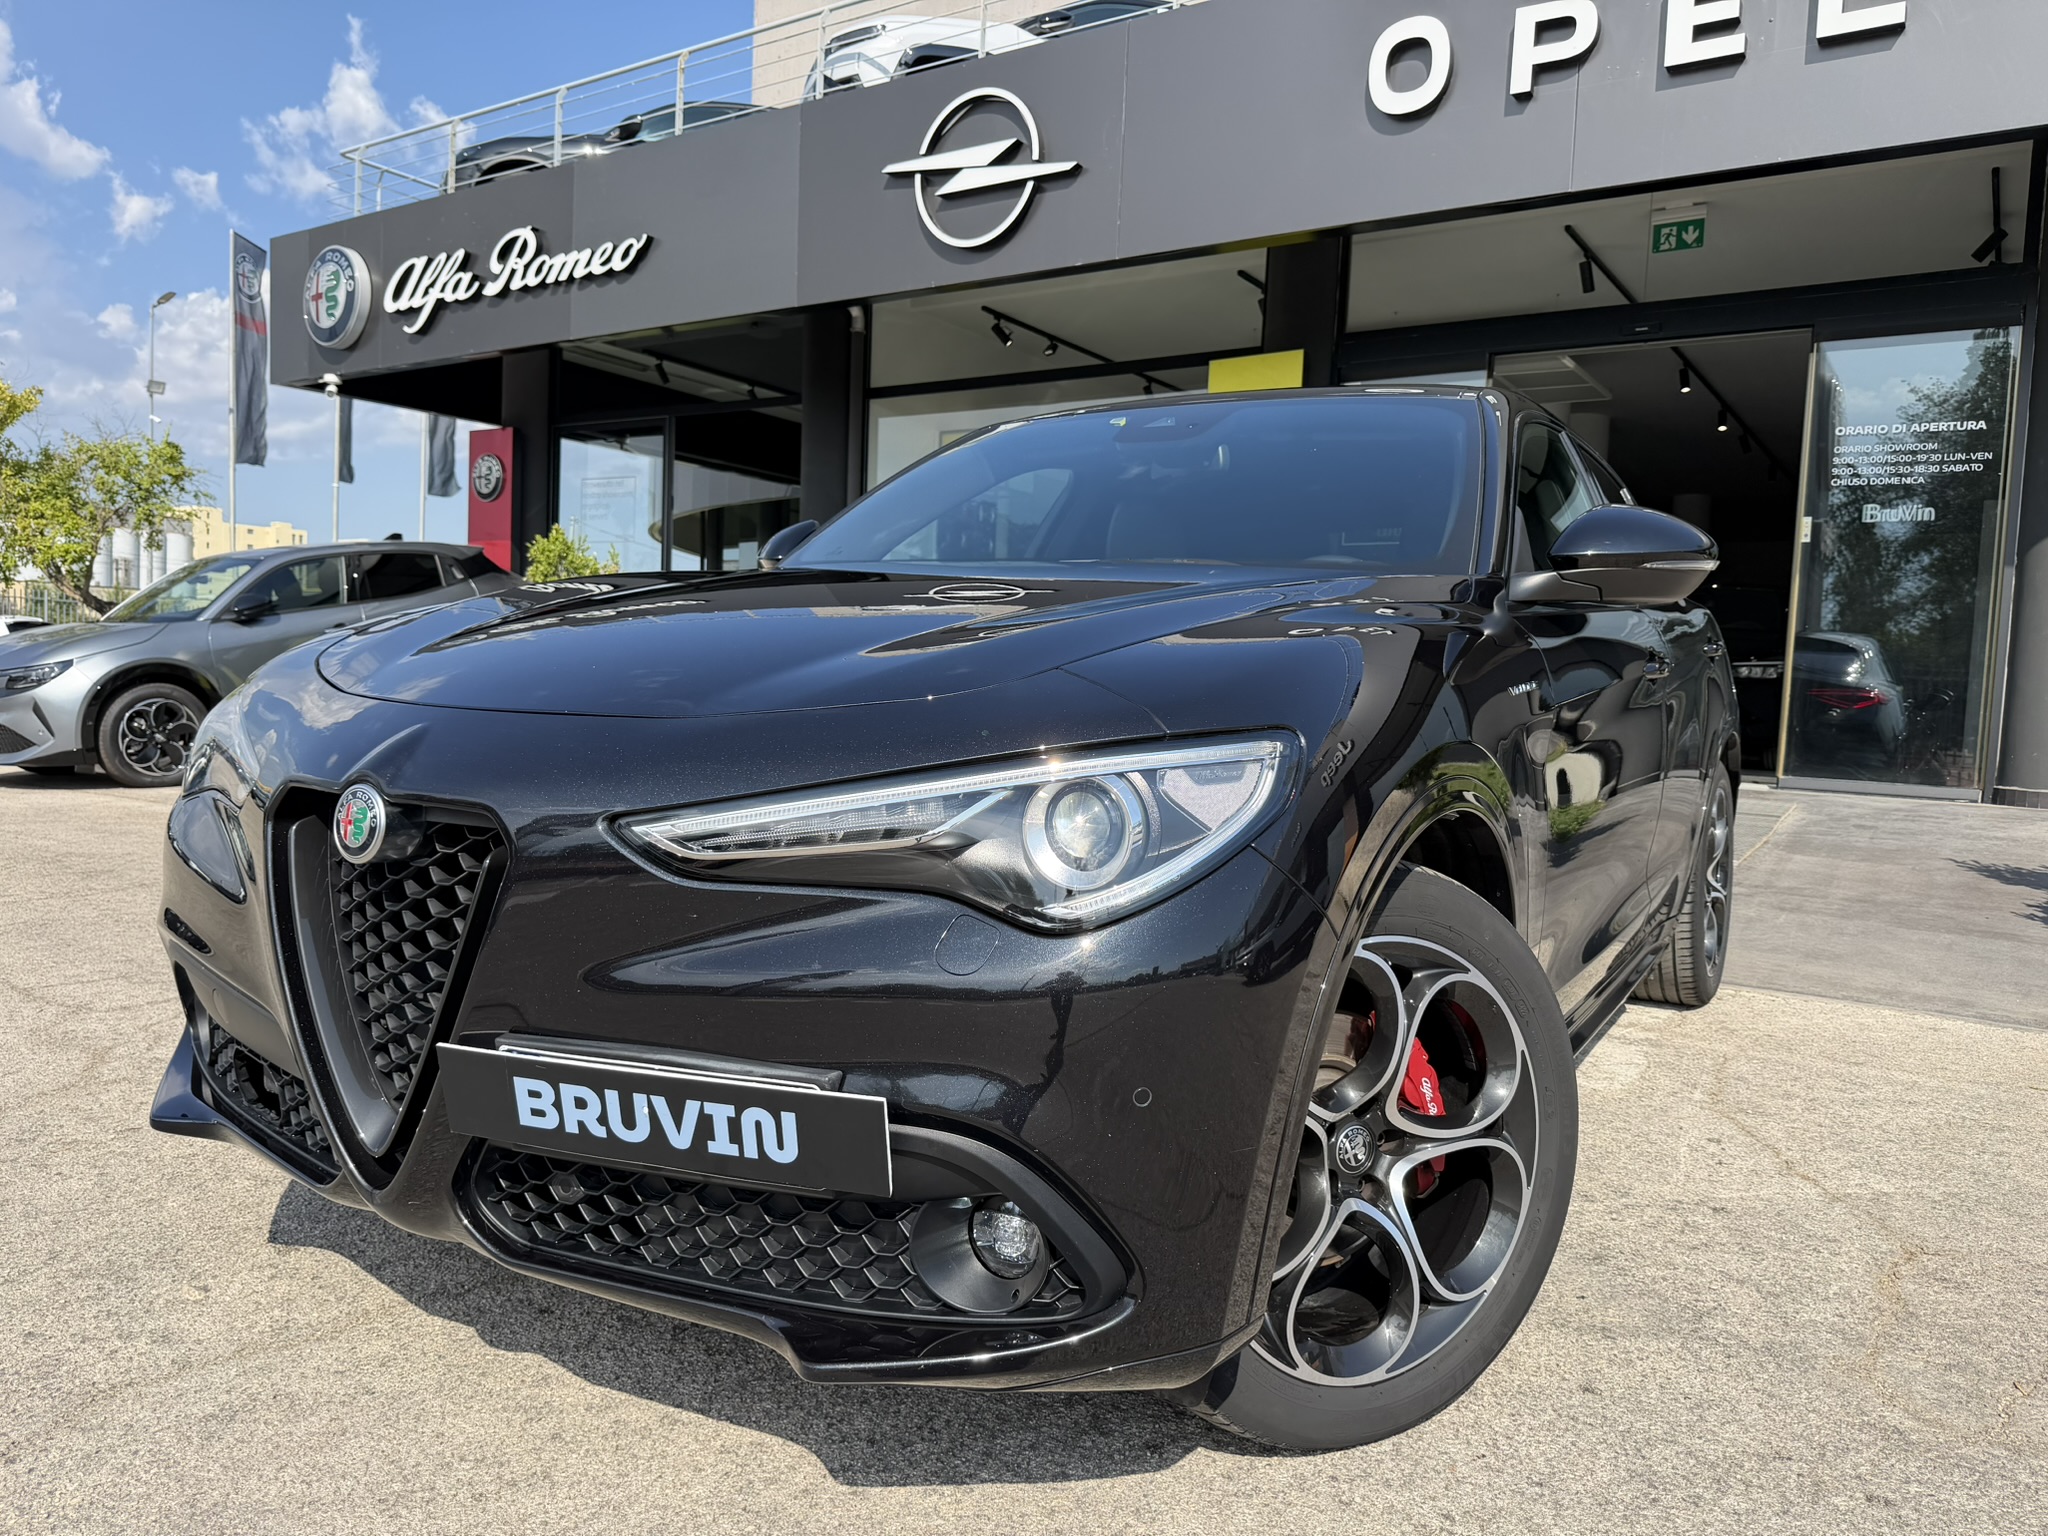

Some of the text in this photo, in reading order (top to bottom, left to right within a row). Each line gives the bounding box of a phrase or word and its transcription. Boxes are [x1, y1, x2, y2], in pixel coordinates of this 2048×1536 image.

[325, 251, 355, 292] ROMEO
[382, 225, 648, 334] Alfa Romeo
[1835, 420, 1987, 436] ORARIO DI APERTURA
[1833, 442, 1937, 453] ORARIO SHOWROOM
[1943, 451, 1993, 461] LUN-VEN
[1941, 463, 1984, 473] SABATO
[1831, 476, 1926, 486] CHIUSO DOMENICA
[338, 792, 377, 827] ALFA ROMEO
[1419, 1077, 1434, 1103] Alfa
[512, 1075, 800, 1165] BRUVIN
[1347, 1128, 1370, 1142] ROMEO
